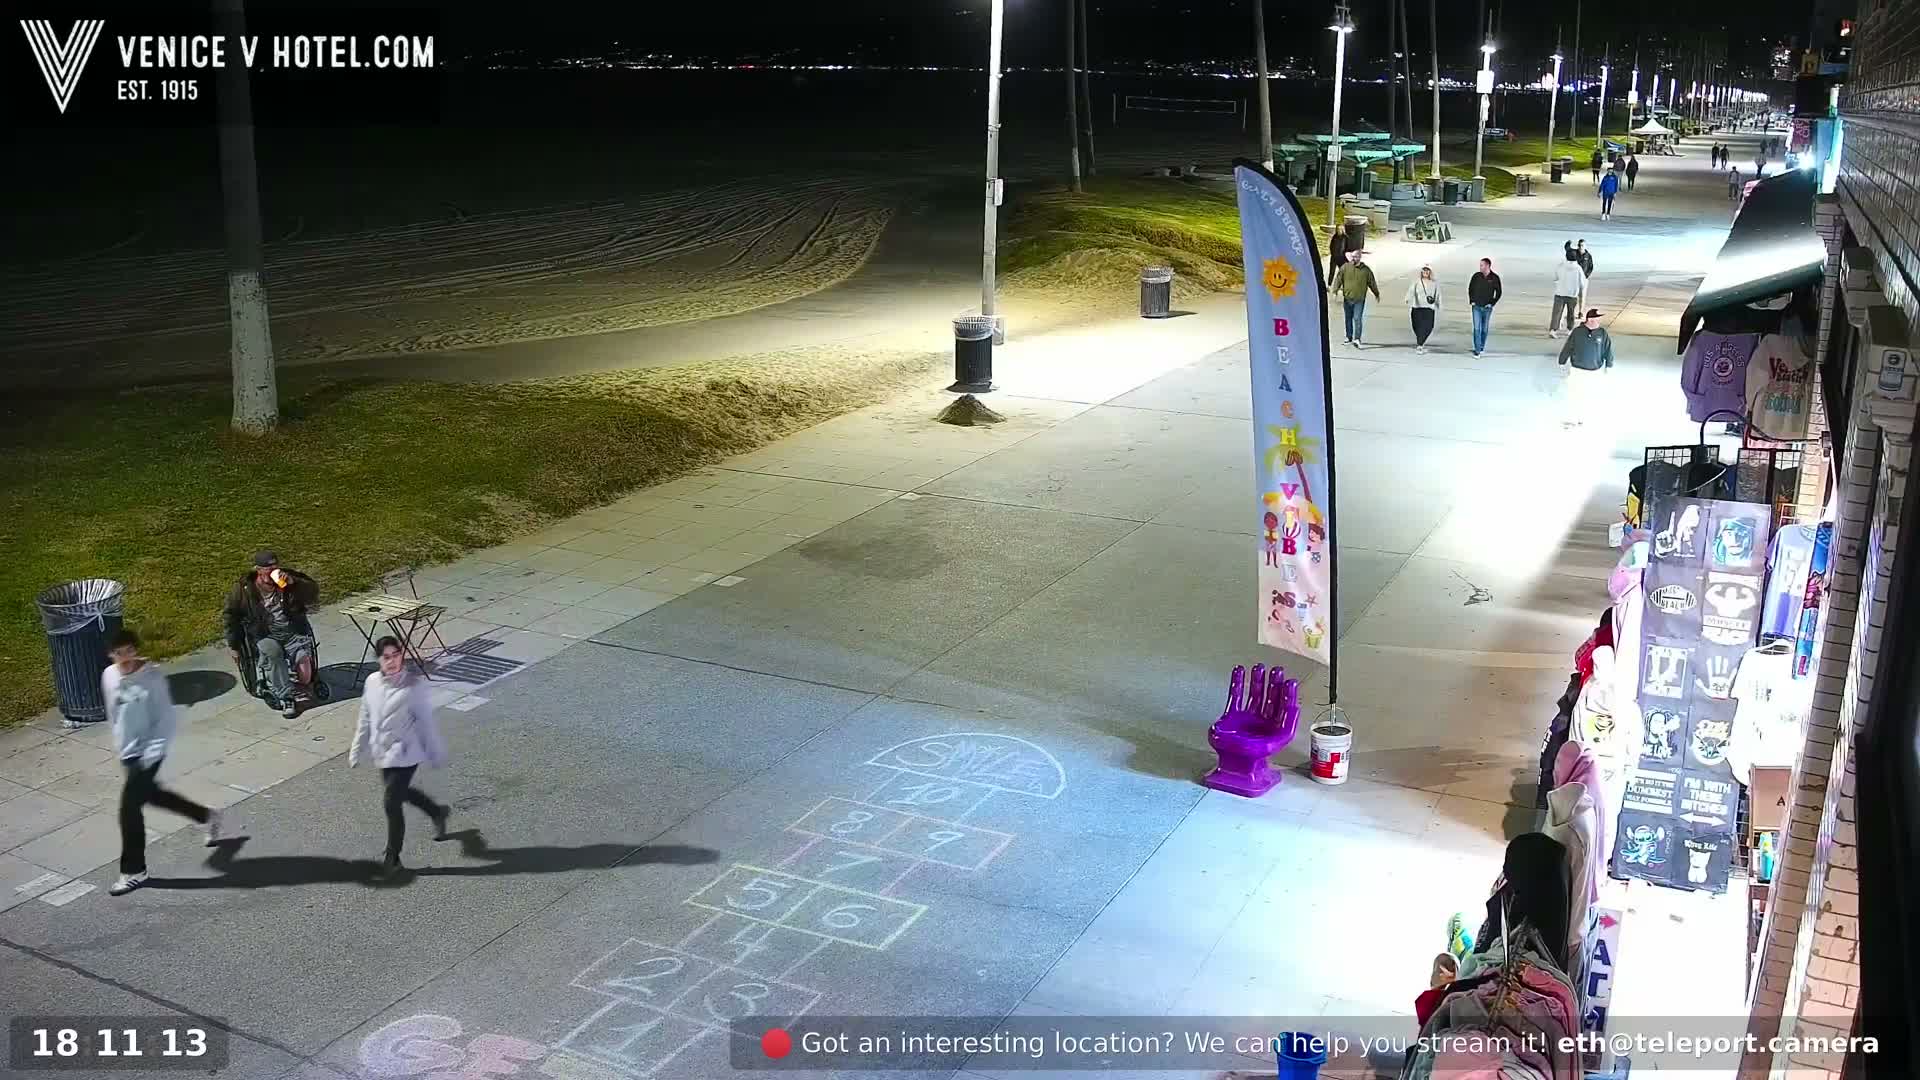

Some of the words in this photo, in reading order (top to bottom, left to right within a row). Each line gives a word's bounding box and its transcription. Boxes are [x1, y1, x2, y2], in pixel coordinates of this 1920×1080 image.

[1273, 317, 1298, 446] BEACH
[1703, 780, 1732, 794] WITH
[832, 811, 875, 833] 8
[925, 831, 965, 855] 9
[726, 876, 792, 911] 5
[822, 904, 878, 928] 6
[604, 956, 685, 995] 2
[703, 982, 770, 1023] 3
